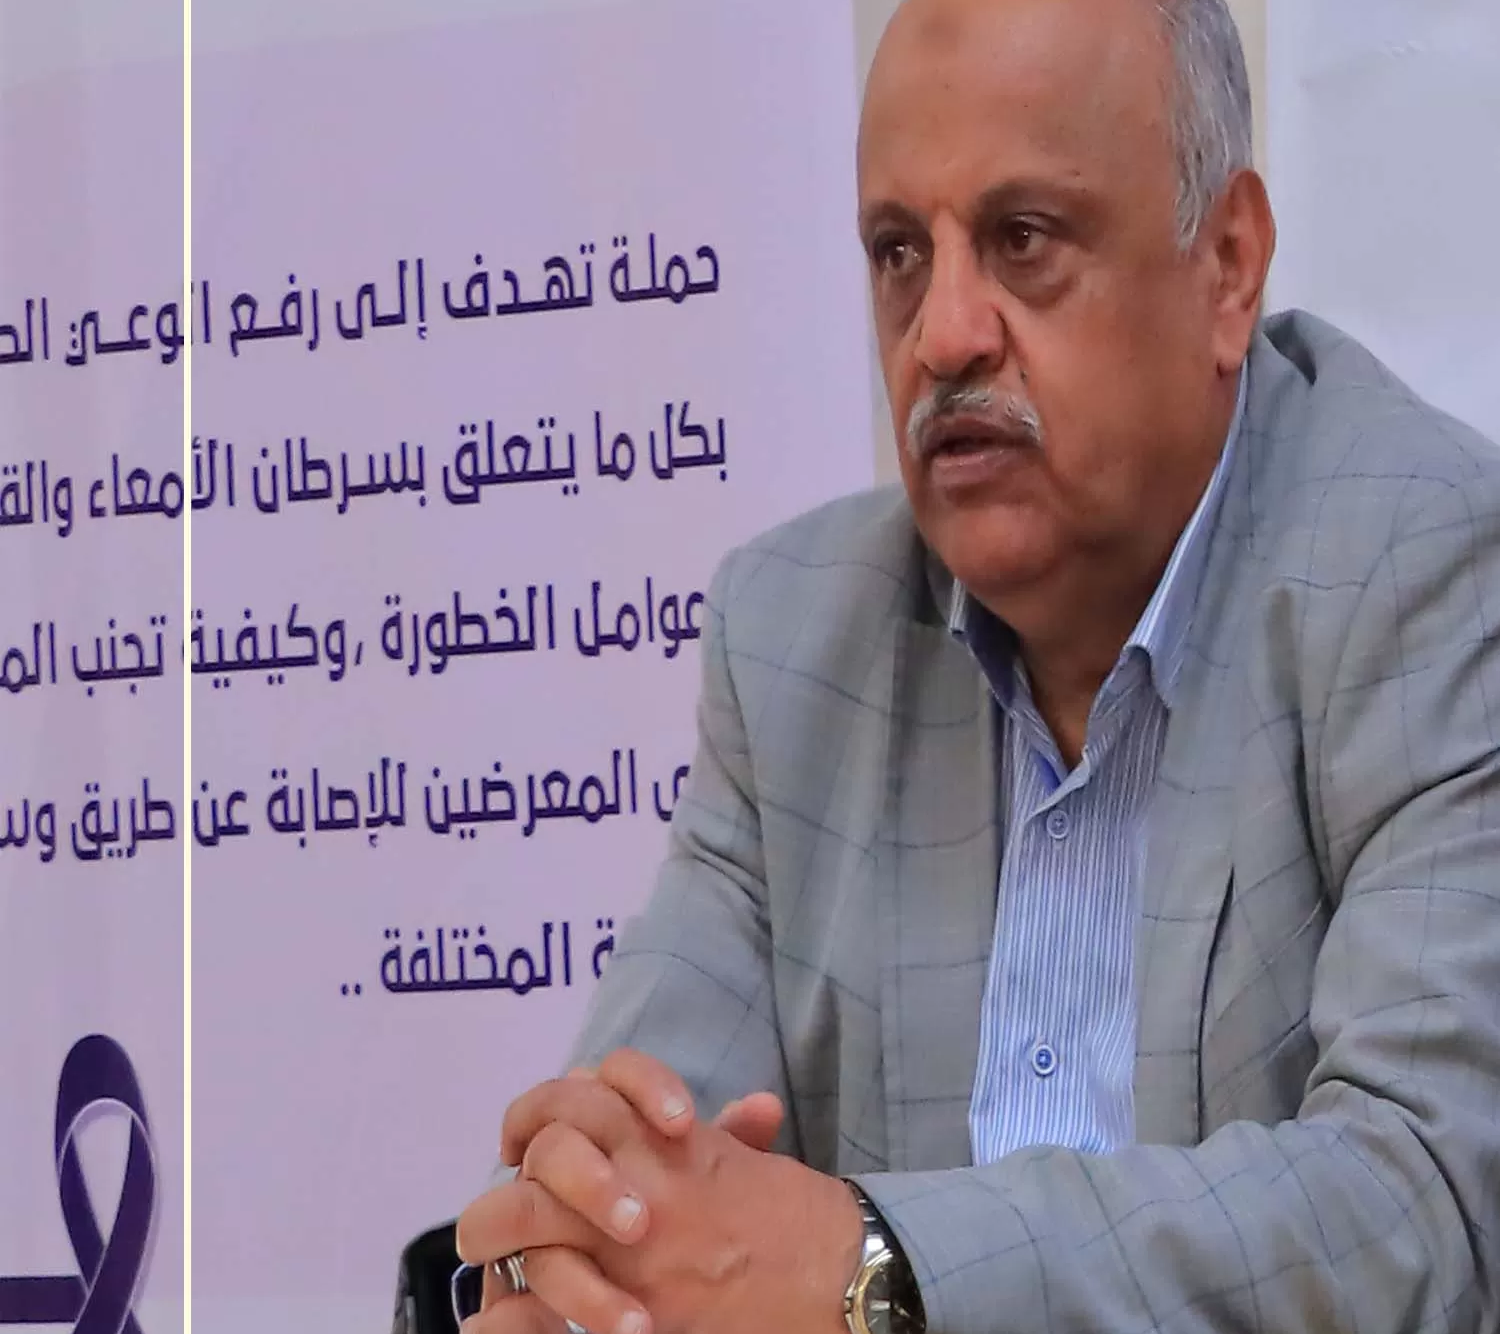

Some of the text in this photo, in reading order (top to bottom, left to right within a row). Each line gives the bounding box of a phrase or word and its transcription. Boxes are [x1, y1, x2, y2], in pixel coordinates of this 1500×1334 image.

[334, 257, 427, 340] إلى
[441, 243, 596, 319] تهدف
[608, 231, 721, 304] حملة
[64, 280, 211, 367] اوعي
[228, 271, 321, 359] رفع
[87, 433, 235, 521] الأمعاء
[252, 439, 427, 516] بسرطان
[442, 412, 582, 507] يتعلق
[593, 410, 636, 479] ما
[647, 399, 728, 482] بكل
[71, 614, 167, 697] تجنب
[379, 583, 557, 676] الخطورة
[573, 576, 706, 661] عوامل
[70, 776, 176, 864] طريق
[192, 776, 251, 849] عن
[266, 756, 407, 849] للإصابة
[424, 747, 638, 838] المعرضين
[379, 920, 572, 995] المختلفة
